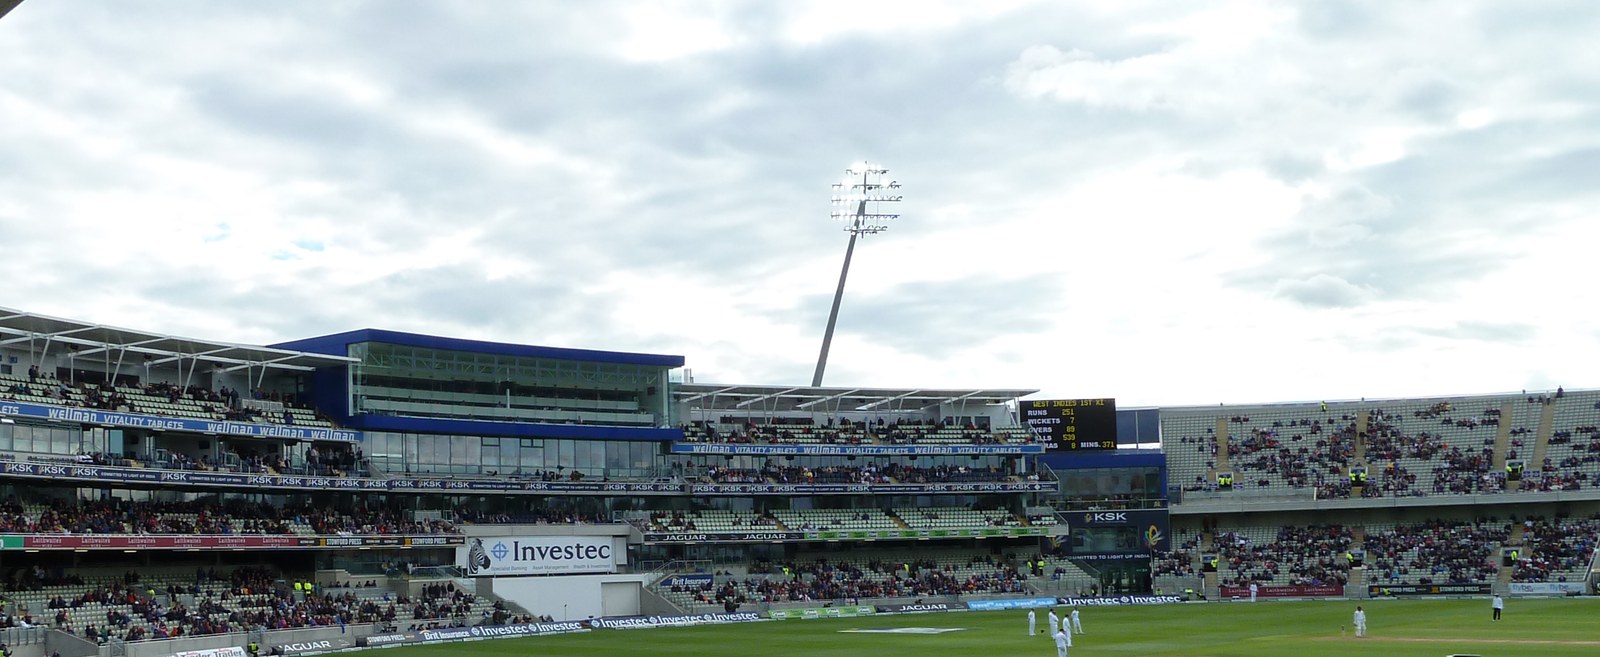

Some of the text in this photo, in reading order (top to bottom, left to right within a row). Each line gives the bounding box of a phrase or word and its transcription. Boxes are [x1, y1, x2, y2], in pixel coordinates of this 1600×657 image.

[0, 405, 19, 414] ETS
[104, 415, 144, 426] VITALITY
[147, 419, 184, 429] TABLETS
[11, 464, 33, 473] KSK
[44, 466, 65, 475] KSK
[77, 468, 98, 477] KSK
[167, 473, 187, 481] KSK
[282, 478, 302, 486] KSK
[1094, 512, 1127, 521] KSK
[513, 541, 611, 561] Investec
[1069, 595, 1181, 605] Investec Investec
[600, 612, 759, 628] Investec Investec Investec
[424, 632, 439, 640] Brit
[480, 622, 581, 637] Investec Investec
[279, 640, 331, 652] AGUAR
